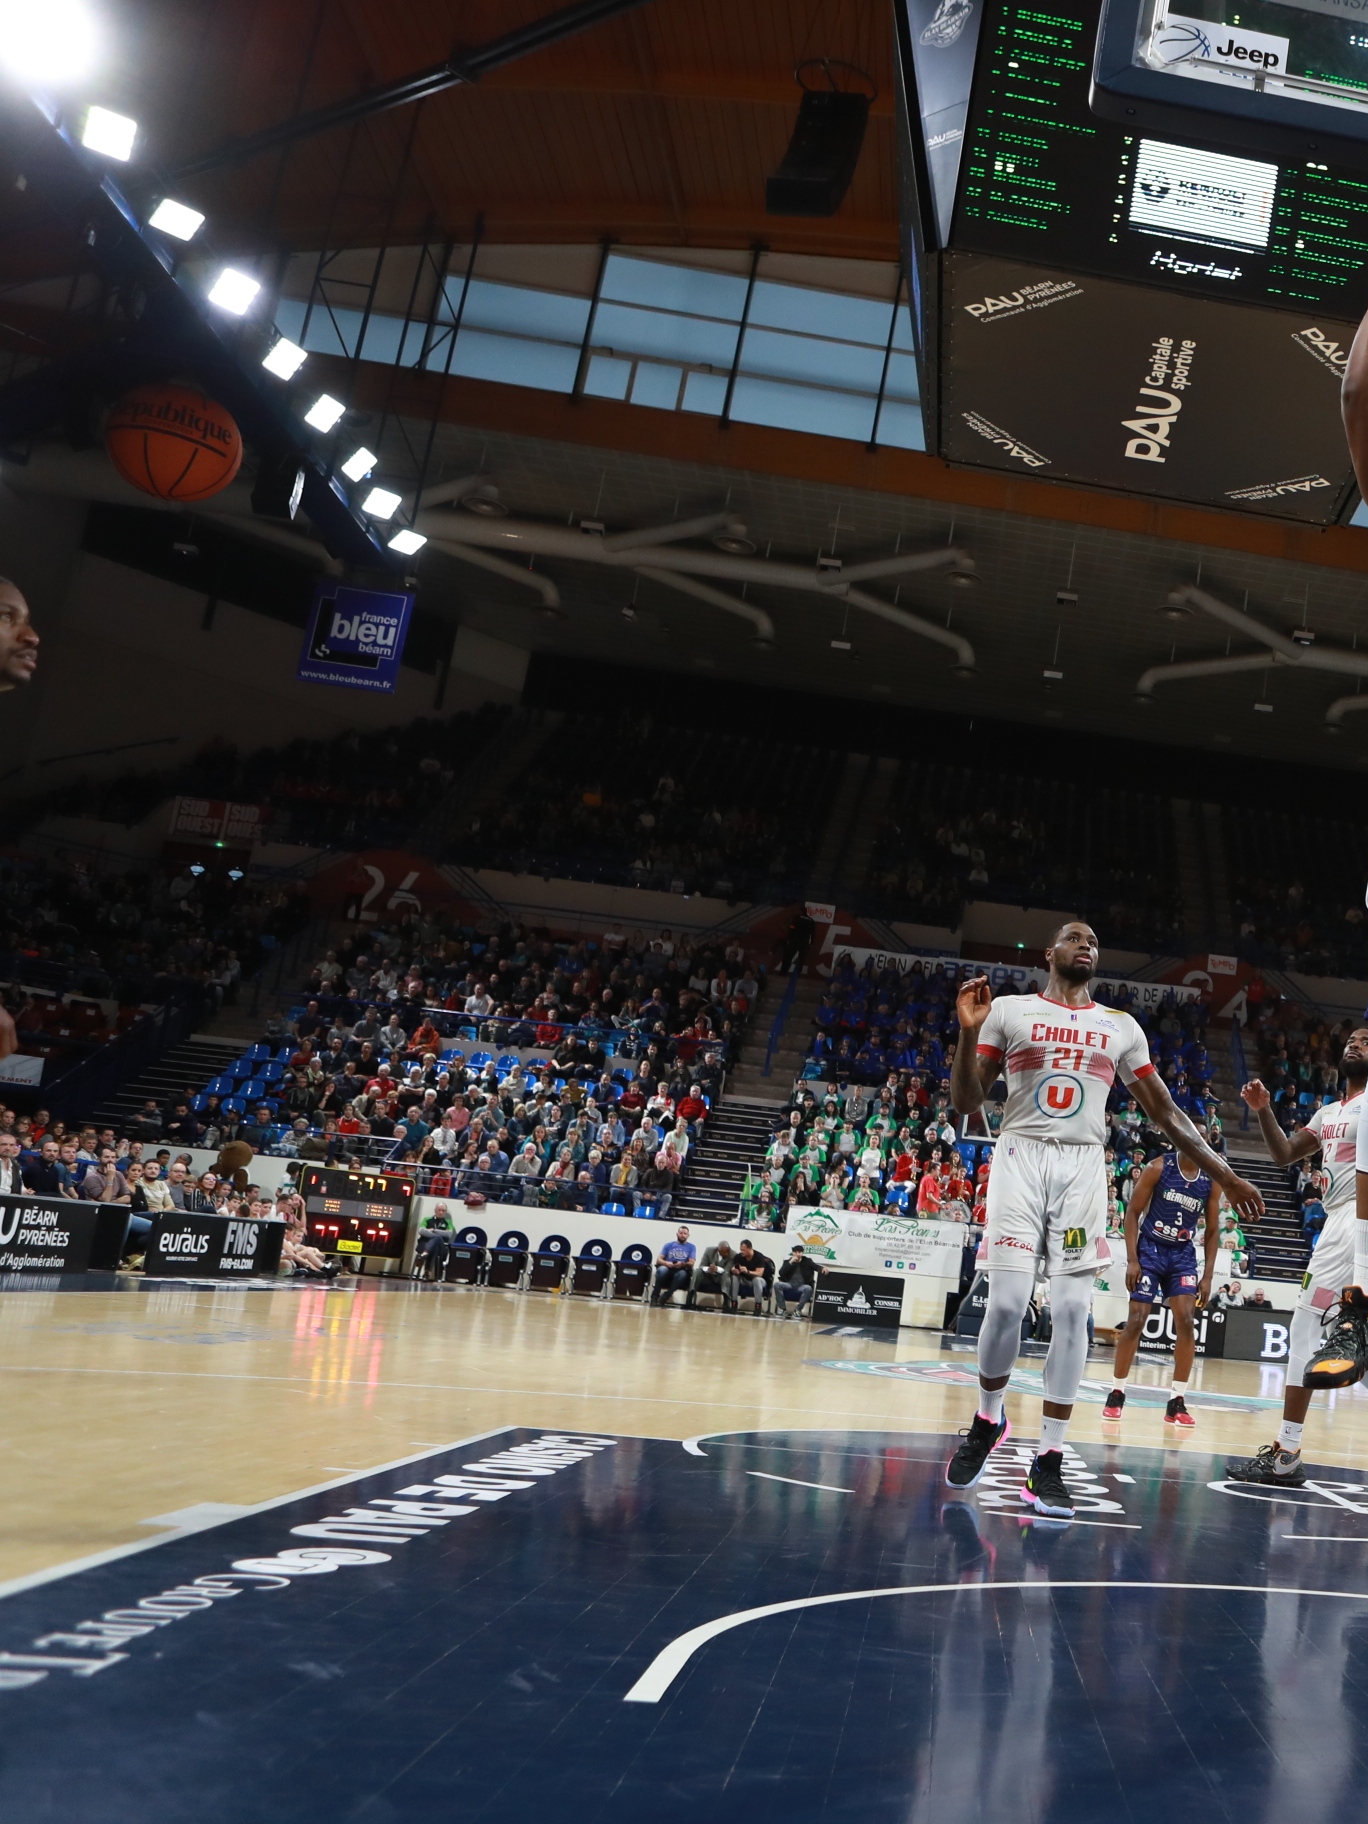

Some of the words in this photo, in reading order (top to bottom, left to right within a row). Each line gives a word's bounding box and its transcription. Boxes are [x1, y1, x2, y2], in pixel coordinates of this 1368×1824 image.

[1217, 39, 1279, 69] Jeep
[964, 292, 1025, 317] PAU
[980, 308, 1025, 323] Communauté
[1026, 289, 1084, 310] d'Agglomération
[1145, 337, 1173, 386] Capitale
[1171, 340, 1196, 390] sportive
[1121, 387, 1182, 463] PAU
[993, 439, 1045, 467] PAU
[1275, 478, 1331, 495] PAU
[330, 612, 396, 646] bleu
[361, 611, 398, 626] france
[358, 642, 391, 656] béarn
[300, 670, 392, 689] www.bleubearn.fr
[1210, 959, 1236, 971] TEMPO
[1143, 988, 1158, 1003] DE
[1031, 1023, 1111, 1050] CHOLET
[1051, 1046, 1084, 1071] 21
[1046, 1085, 1075, 1110] U
[1175, 1211, 1183, 1226] 3
[223, 1221, 259, 1256] FMS
[873, 1234, 905, 1243] supporters
[0, 1251, 65, 1270] d'Agglomération
[817, 1294, 844, 1303] AD'HOC
[837, 1306, 878, 1316] IMMOBILIER
[462, 1434, 619, 1477] CASINO
[392, 1473, 538, 1502] DE
[290, 1499, 480, 1544] PAU
[32, 1573, 291, 1649] GROUPE
